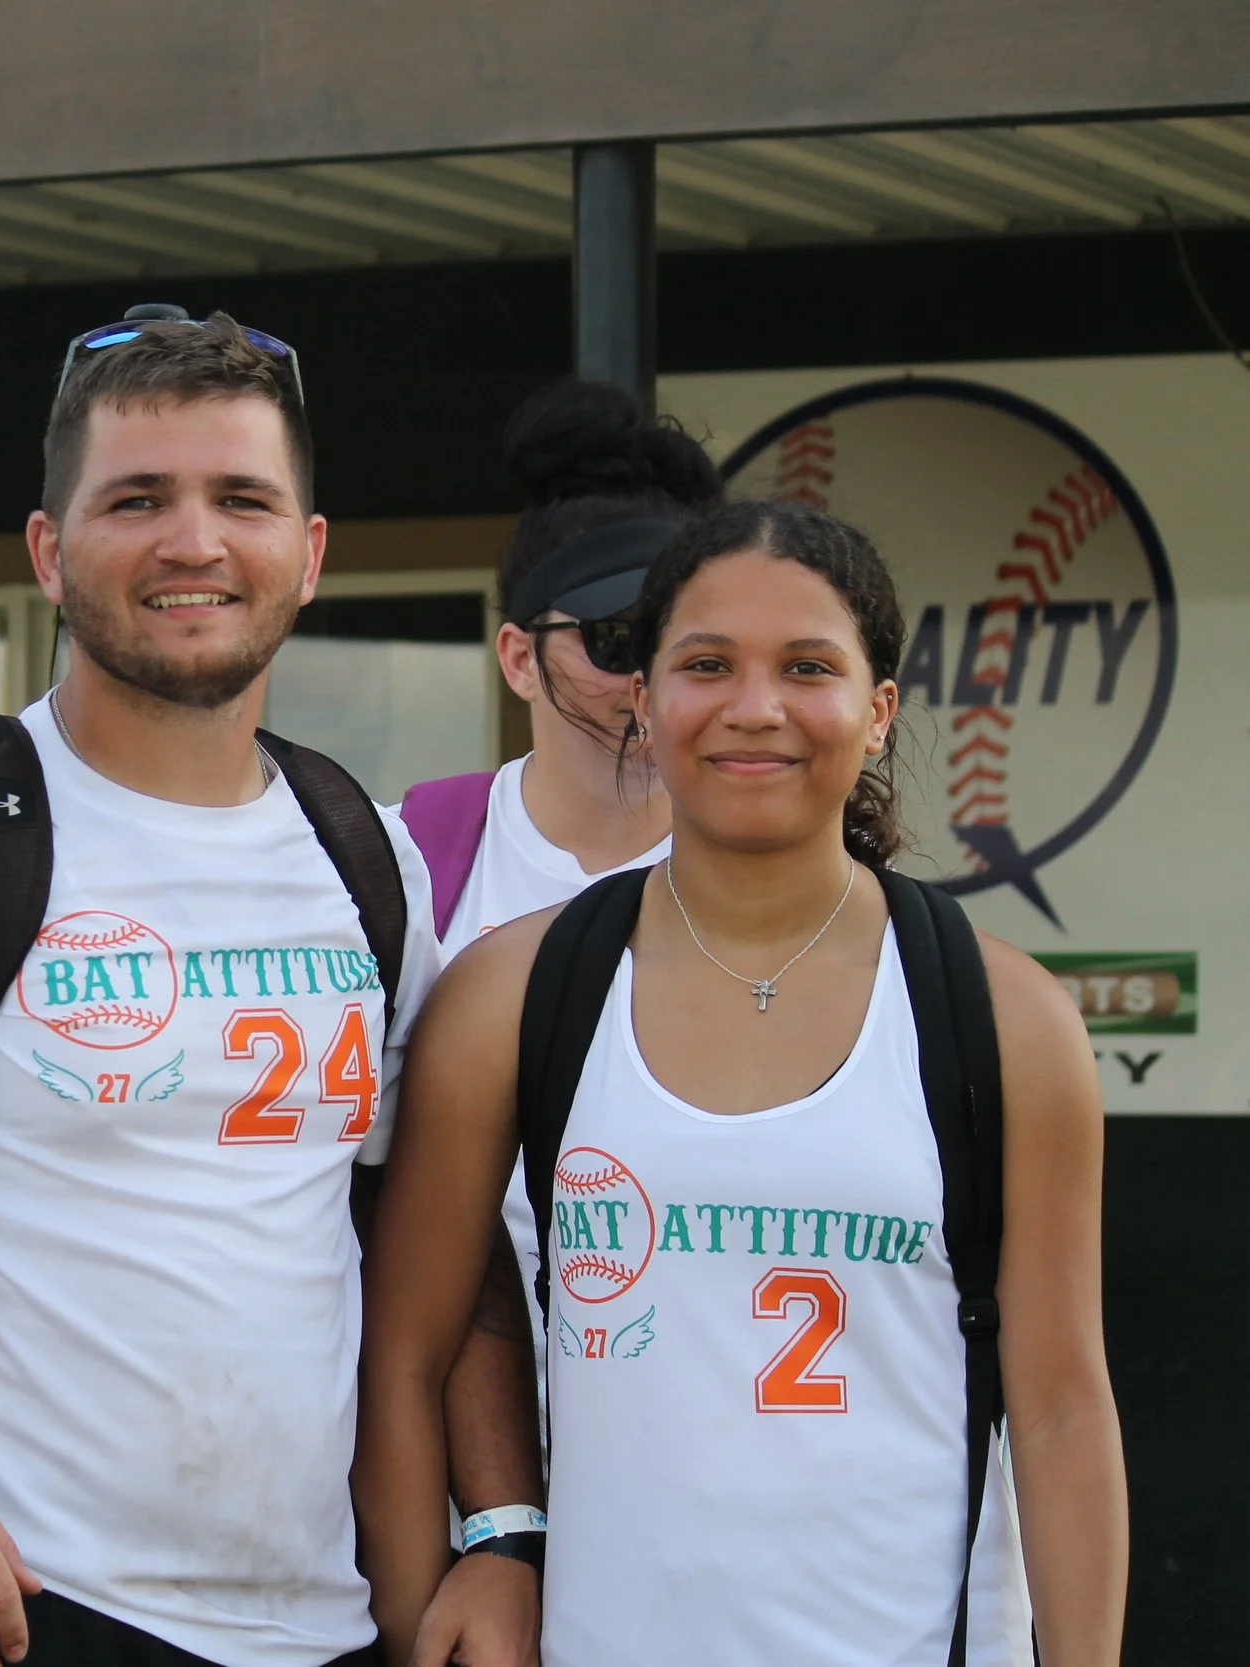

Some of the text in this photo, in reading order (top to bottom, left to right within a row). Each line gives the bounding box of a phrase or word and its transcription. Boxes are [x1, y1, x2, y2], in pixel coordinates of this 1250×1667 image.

[897, 600, 1149, 705] ALITY
[40, 947, 380, 1006] BAT ATTITUDE
[97, 1073, 131, 1104] 27
[217, 1002, 379, 1145] 24
[555, 1200, 934, 1264] BAT ATTITUDE
[584, 1328, 607, 1359] 27
[752, 1267, 847, 1414] 2
